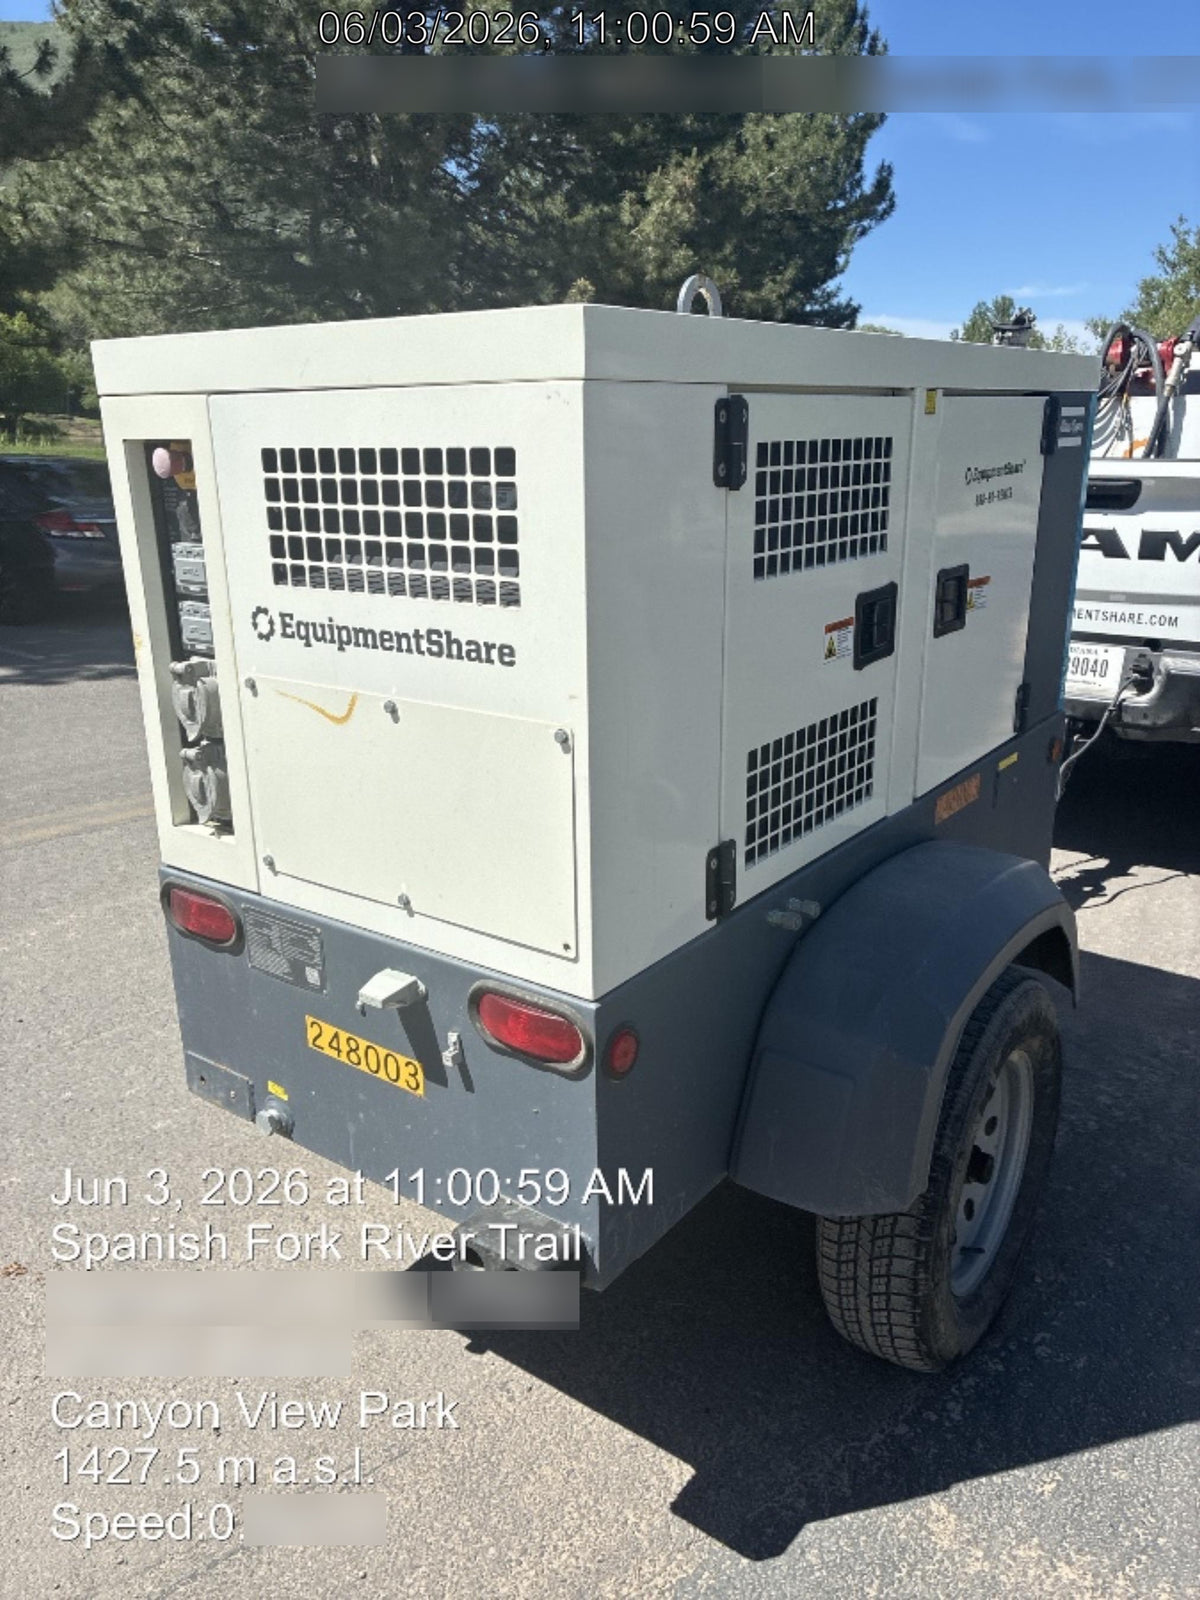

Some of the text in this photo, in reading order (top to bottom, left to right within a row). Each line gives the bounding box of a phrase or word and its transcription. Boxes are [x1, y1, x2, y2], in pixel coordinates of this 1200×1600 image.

[278, 611, 517, 668] EquipmentShare
[1069, 656, 1109, 678] 9040
[310, 1021, 420, 1091] 248003
